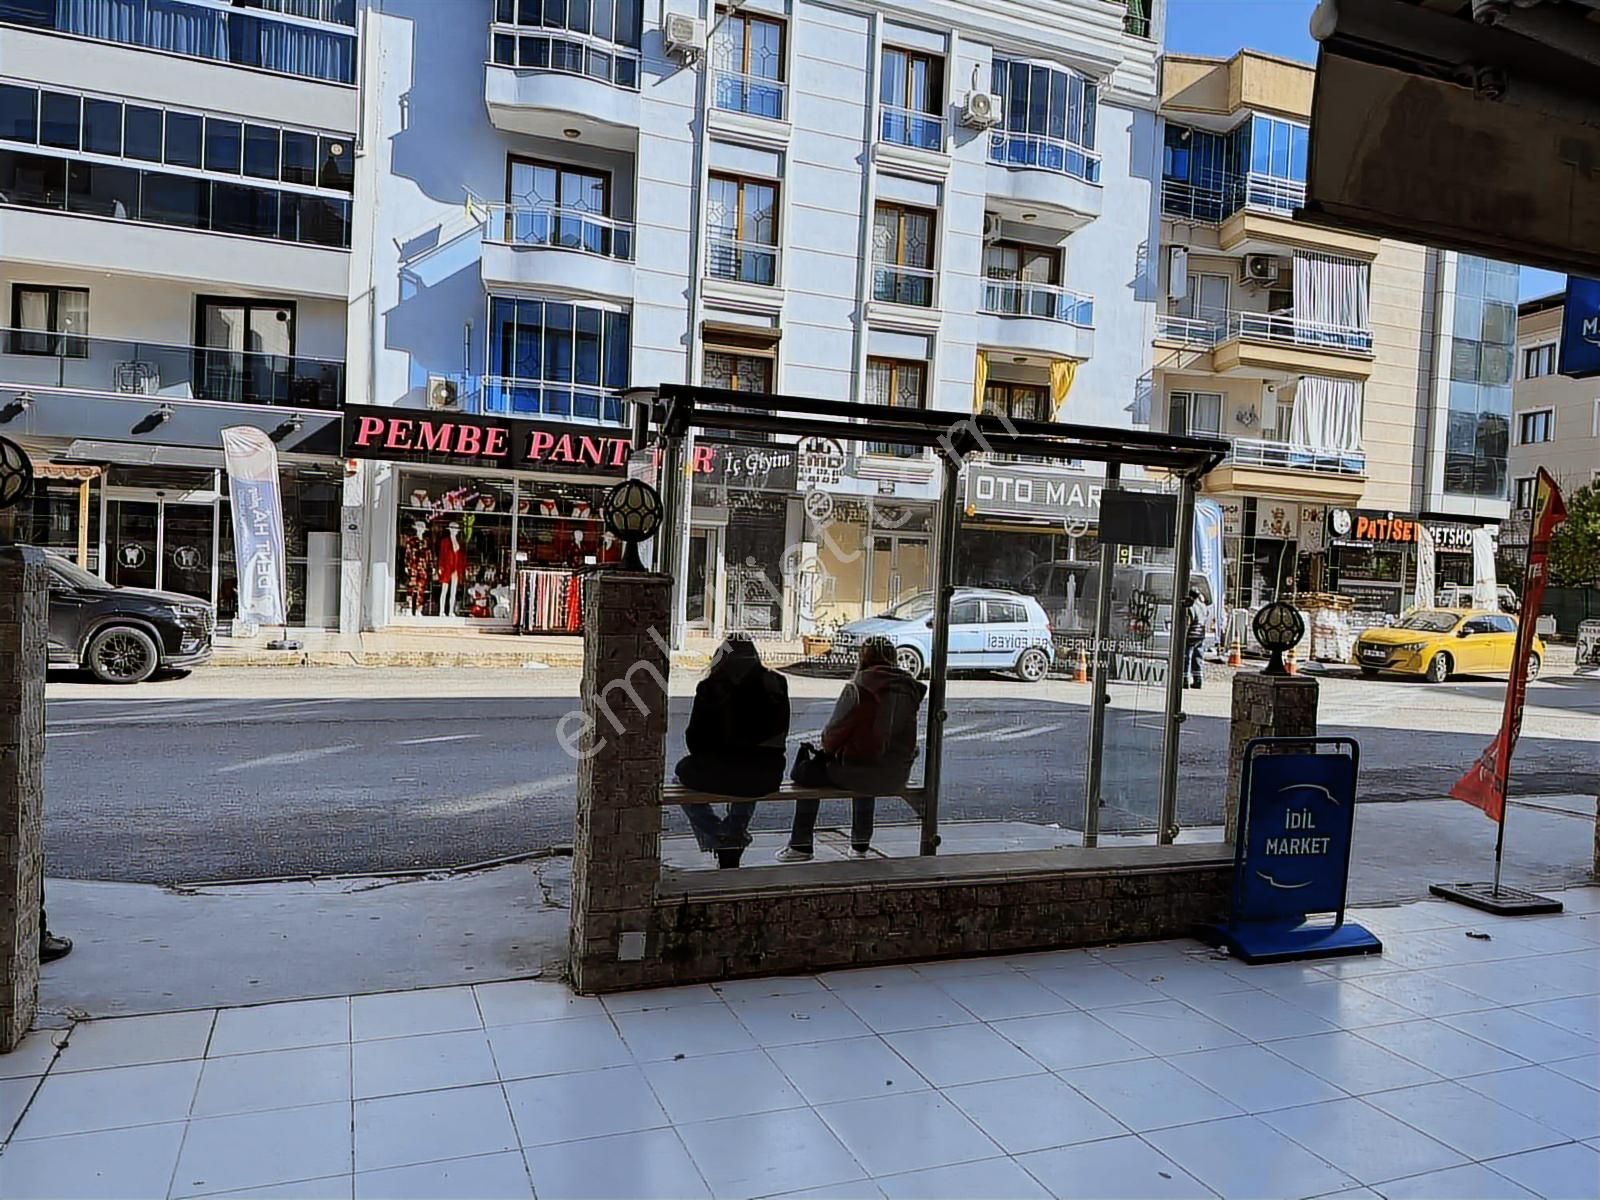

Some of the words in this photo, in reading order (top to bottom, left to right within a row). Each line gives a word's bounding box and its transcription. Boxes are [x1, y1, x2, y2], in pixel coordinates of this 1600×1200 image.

[1582, 317, 1600, 336] M
[354, 416, 512, 456] PEMBE
[527, 431, 714, 473] PANTR
[745, 451, 791, 476] Giyim
[976, 475, 1033, 502] OTO
[1429, 526, 1473, 545] ETSHO
[1285, 808, 1316, 830] İDİL
[1265, 837, 1331, 855] MARKET
